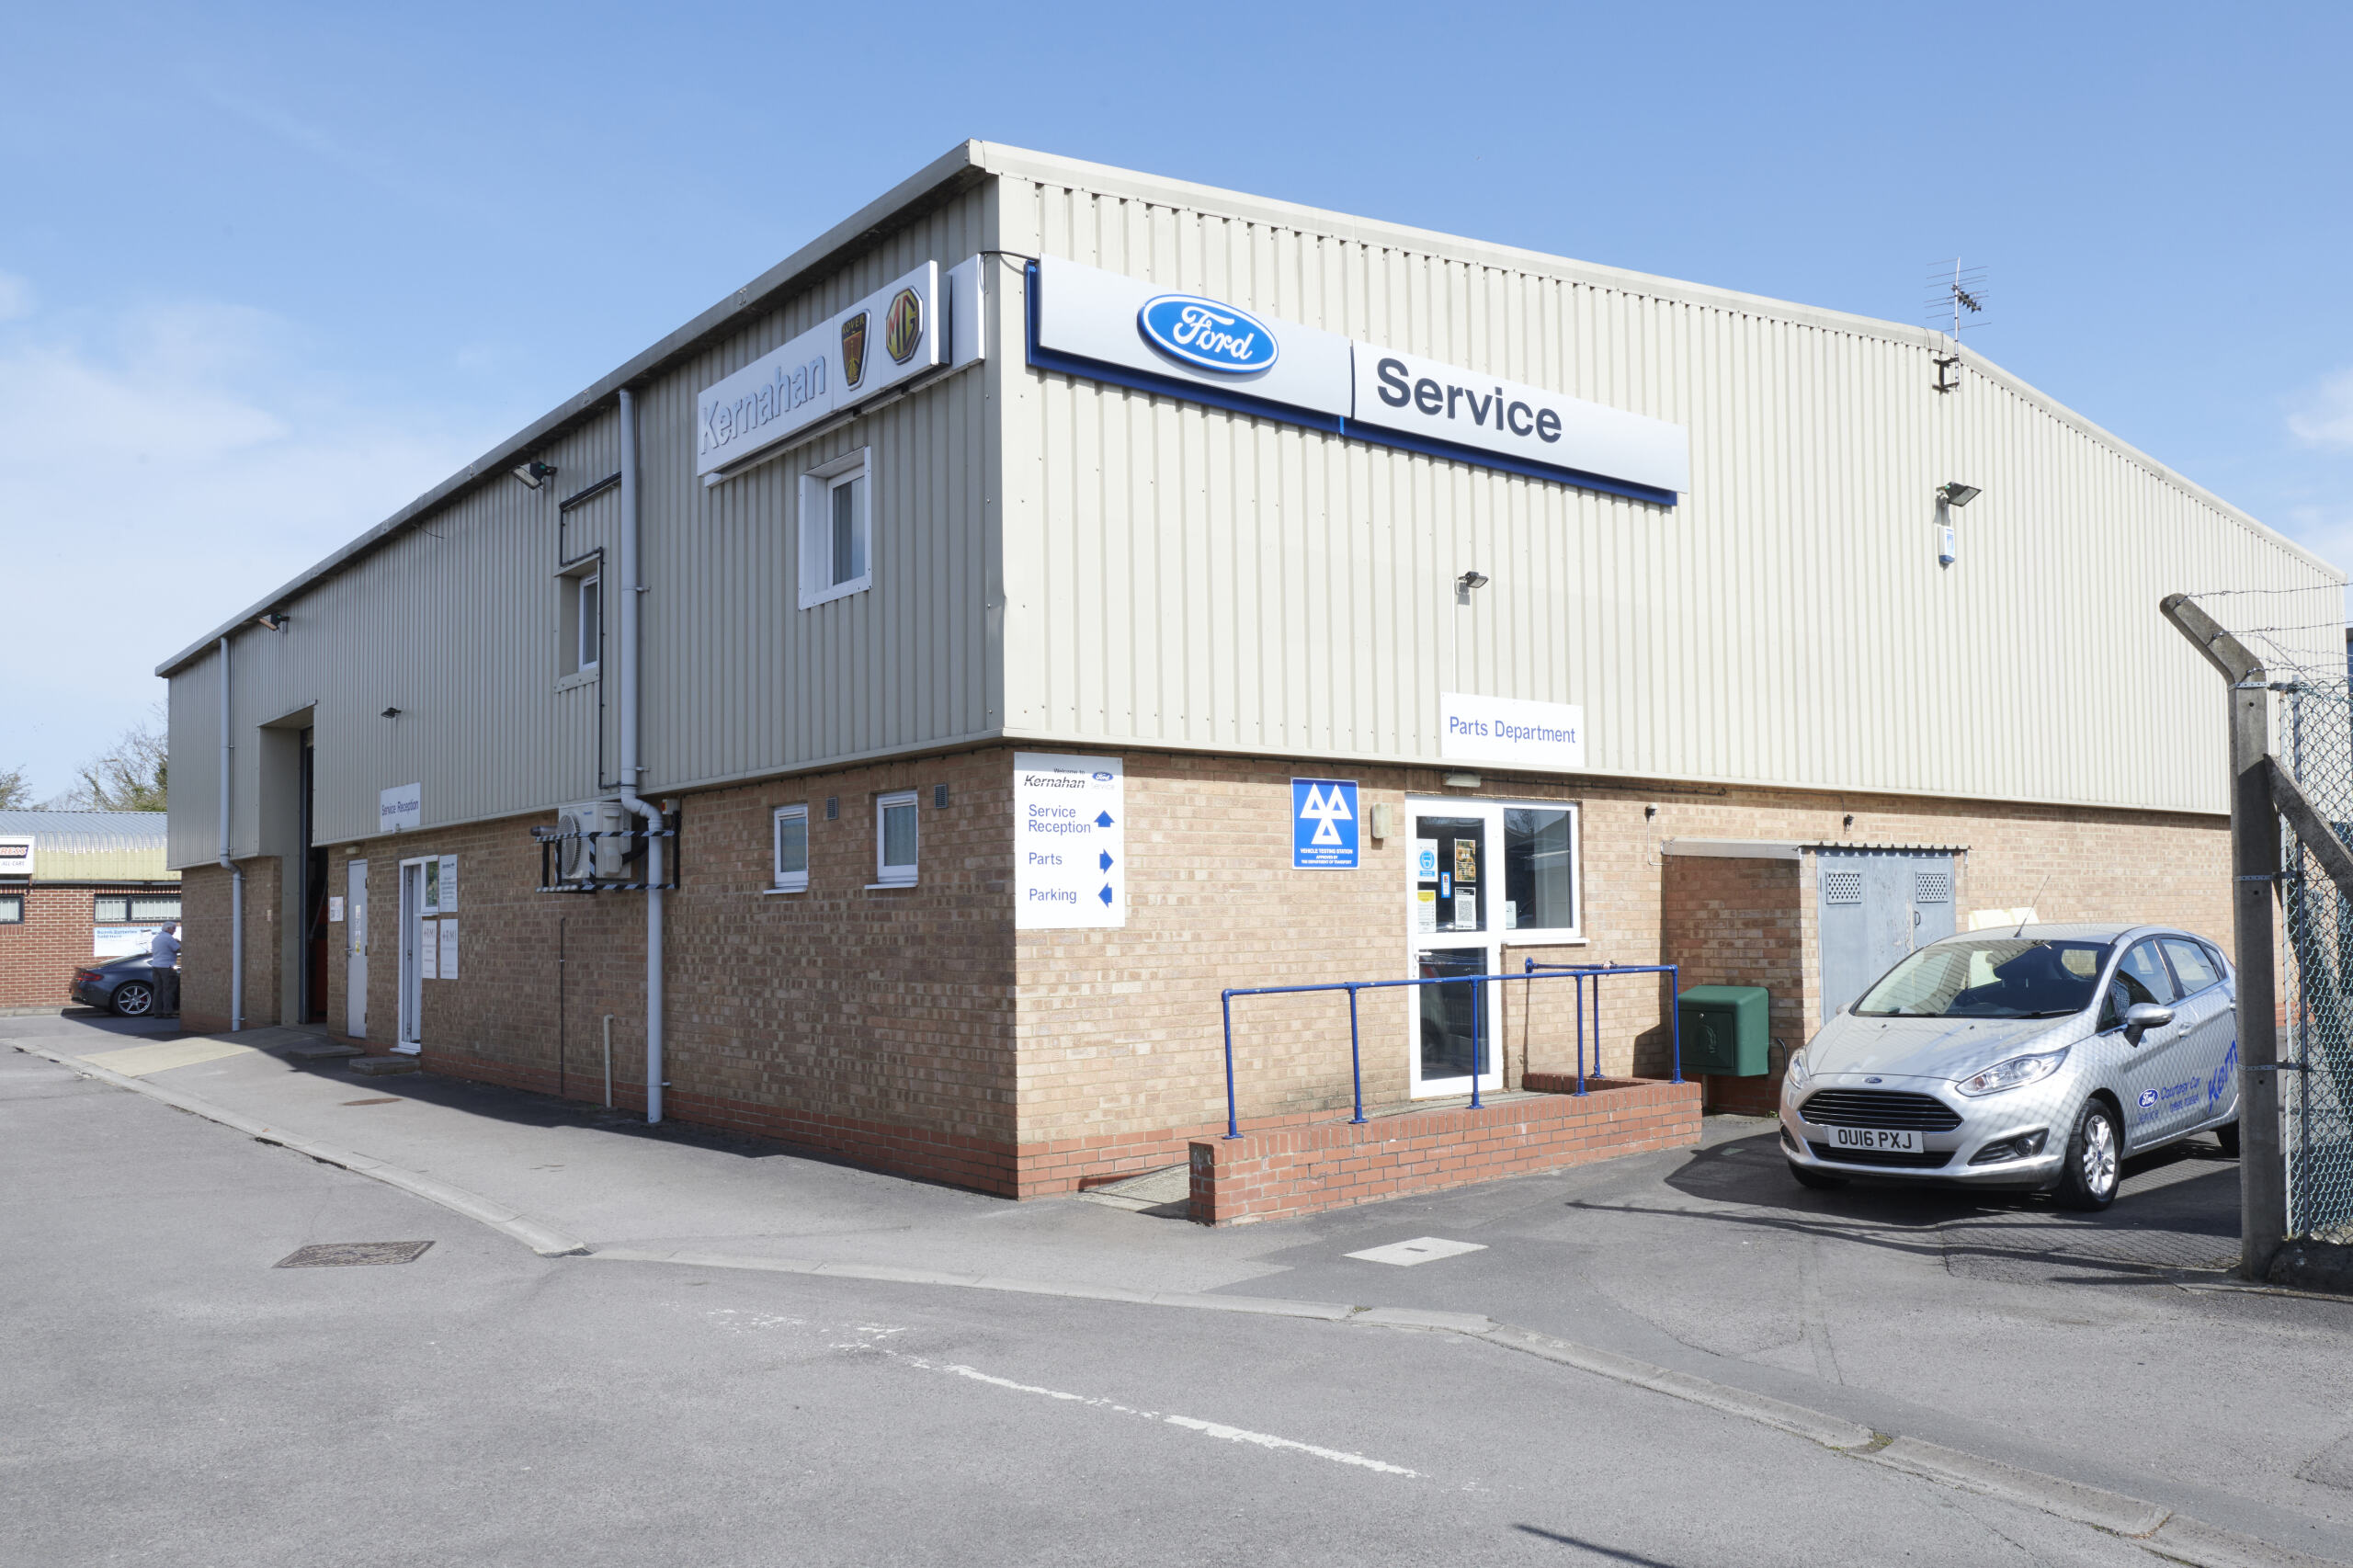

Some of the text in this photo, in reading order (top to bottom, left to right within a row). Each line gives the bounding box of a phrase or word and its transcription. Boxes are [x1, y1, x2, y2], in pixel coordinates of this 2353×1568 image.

[842, 313, 865, 334] ROVER
[889, 294, 915, 355] MG
[1173, 305, 1563, 444] Ford Service
[700, 355, 826, 456] Kernahan
[1449, 716, 1576, 744] Parts Department
[1023, 774, 1086, 789] Kernahan
[1096, 772, 1110, 780] Ford
[381, 799, 419, 816] Service Reception
[1029, 803, 1076, 818] Service
[1029, 820, 1091, 835] Reception
[1029, 851, 1063, 865] Parts
[1029, 888, 1077, 903] Parking
[2161, 1076, 2200, 1100] Courtesy Car
[1837, 1129, 1912, 1149] OU16 PXJ
